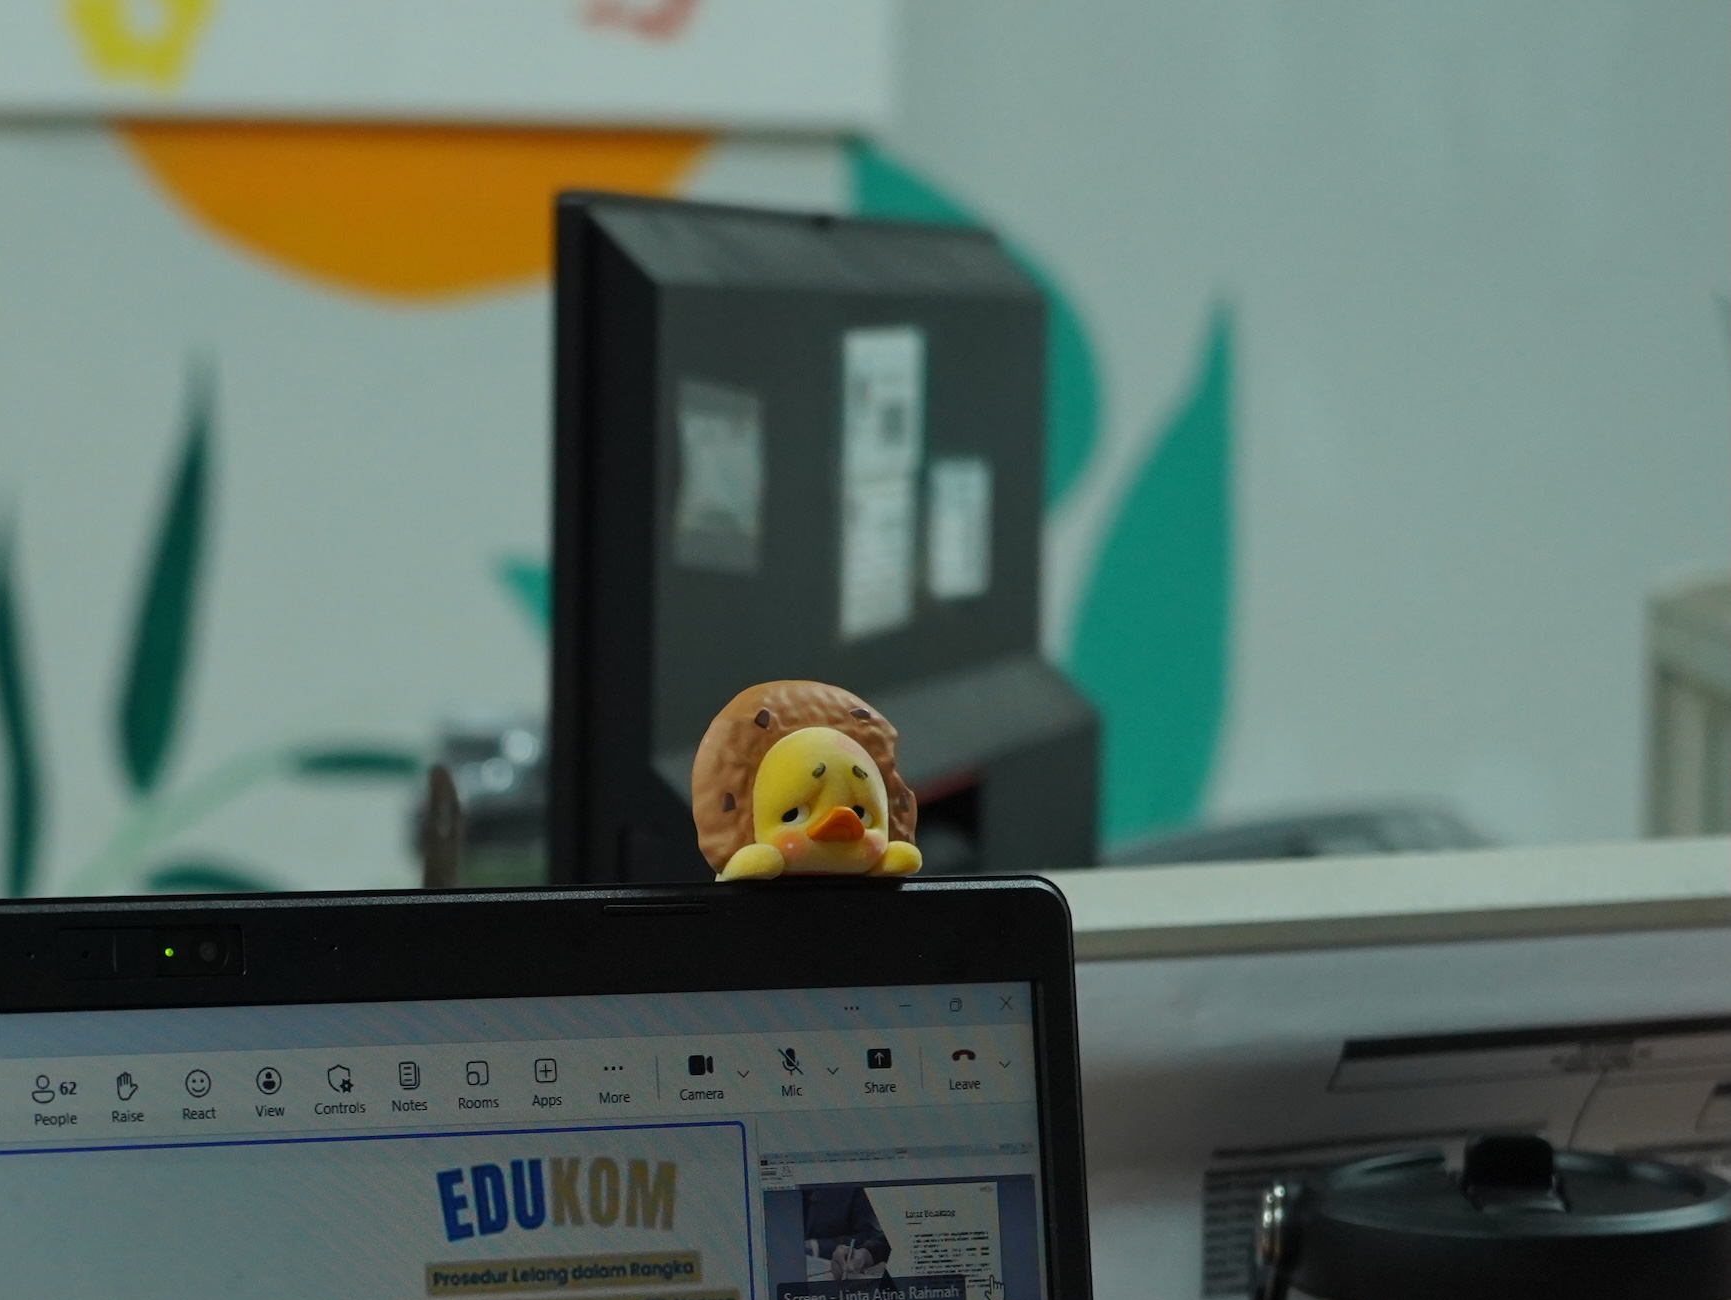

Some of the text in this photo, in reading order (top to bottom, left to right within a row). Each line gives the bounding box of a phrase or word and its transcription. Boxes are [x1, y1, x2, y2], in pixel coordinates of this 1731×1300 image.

[59, 1082, 77, 1096] 62
[781, 1084, 803, 1098] Mic
[864, 1081, 897, 1094] Share
[949, 1078, 981, 1091] Leave
[532, 1094, 562, 1109] Apps
[599, 1091, 631, 1104] More
[679, 1088, 724, 1101] Camera
[314, 1102, 366, 1116] Controls
[392, 1100, 428, 1112] Notes
[458, 1097, 499, 1110] Rooms
[112, 1110, 144, 1123] Raise
[182, 1107, 216, 1121] React
[255, 1105, 285, 1117] View
[34, 1113, 77, 1128] People
[436, 1156, 677, 1242] EDUKOM
[433, 1260, 694, 1288] Prosedur Lelang dalam Rangka
[909, 1285, 959, 1300] Rahmah
